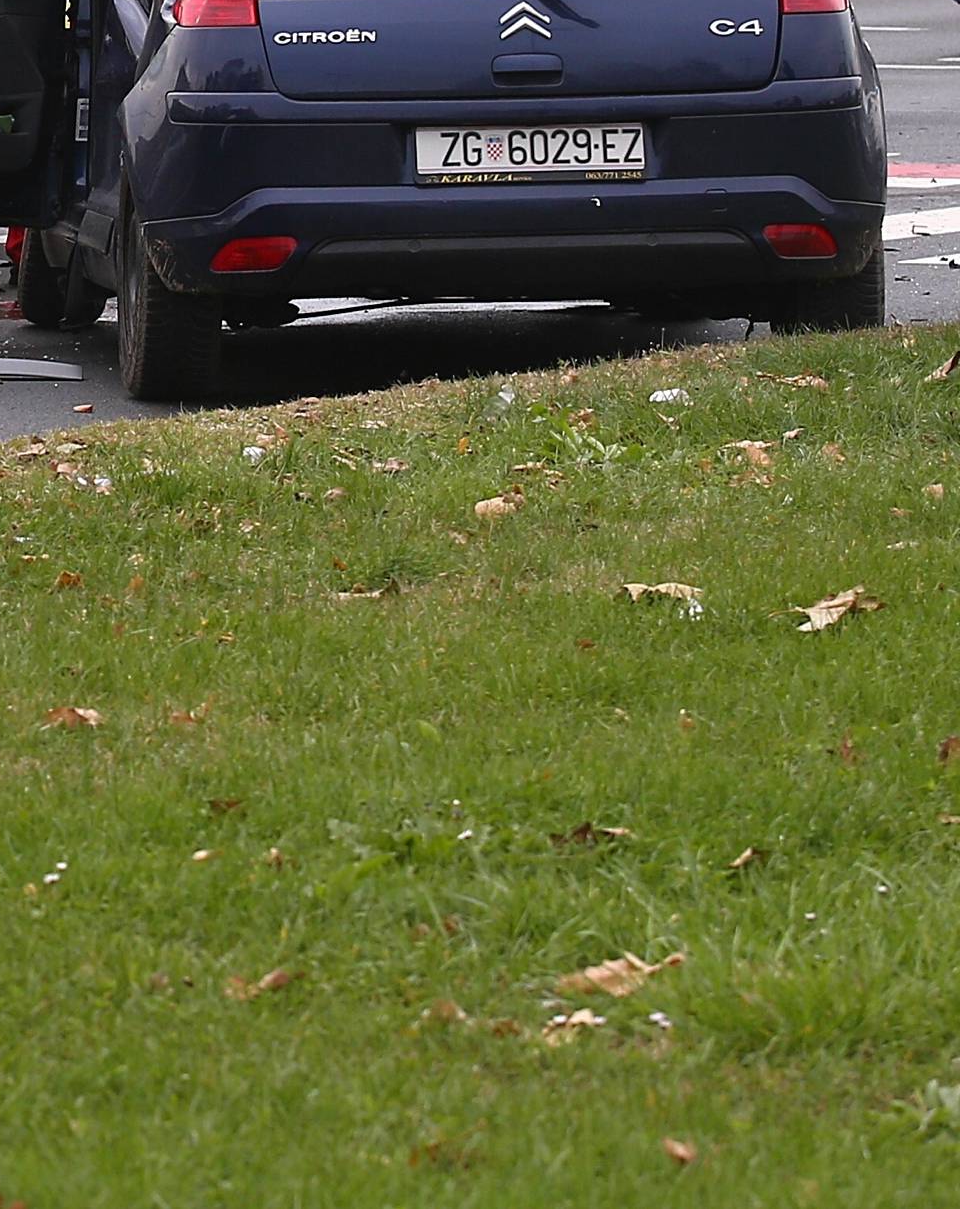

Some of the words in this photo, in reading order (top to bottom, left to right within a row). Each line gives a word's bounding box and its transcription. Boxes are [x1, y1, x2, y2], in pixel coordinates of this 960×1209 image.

[709, 19, 763, 35] C4
[274, 29, 376, 44] CITROËN
[441, 131, 482, 166] ZG
